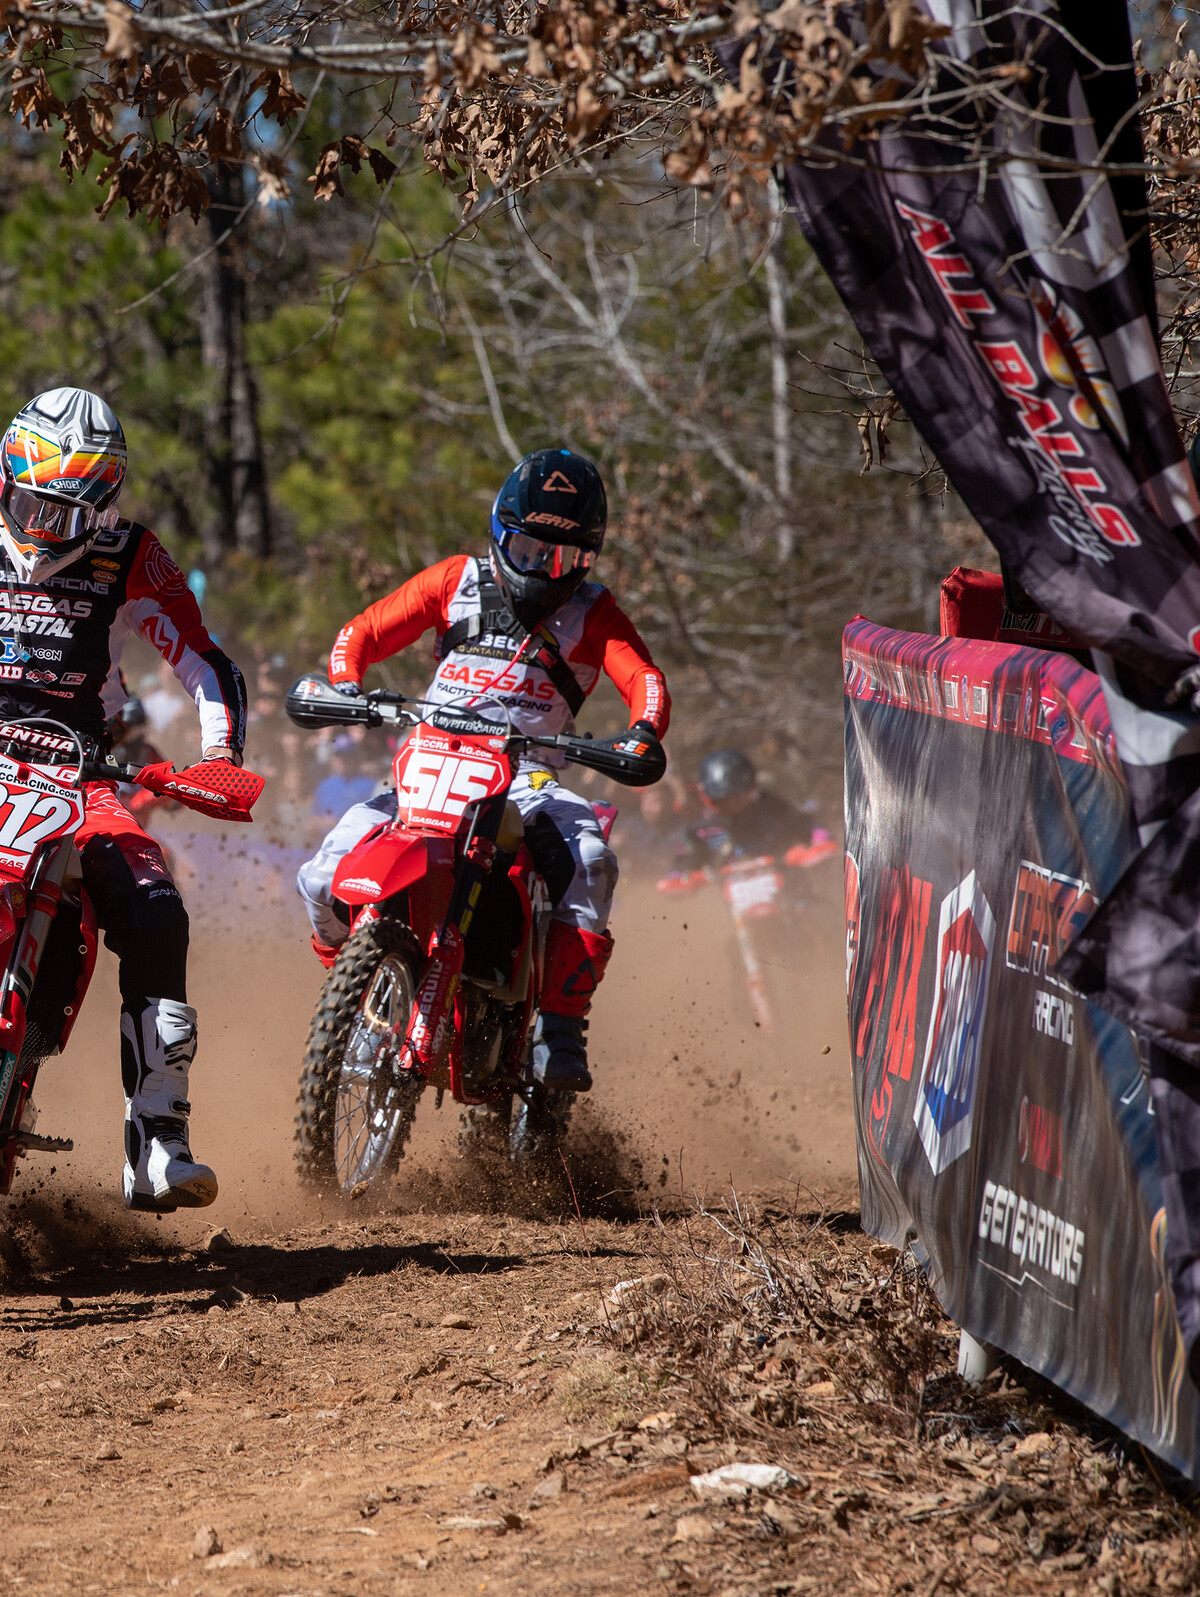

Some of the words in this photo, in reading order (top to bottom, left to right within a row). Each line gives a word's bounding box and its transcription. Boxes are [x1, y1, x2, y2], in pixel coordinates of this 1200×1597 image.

[896, 199, 996, 330] ALL
[973, 340, 1142, 547] BALLS
[52, 480, 80, 490] SHOEI
[525, 511, 582, 531] LEATT
[440, 664, 557, 700] GASGAS
[409, 738, 493, 759] GNCCRANG.COM
[399, 752, 497, 816] 515
[412, 816, 452, 829] GASGAS
[1032, 989, 1074, 1046] RACING
